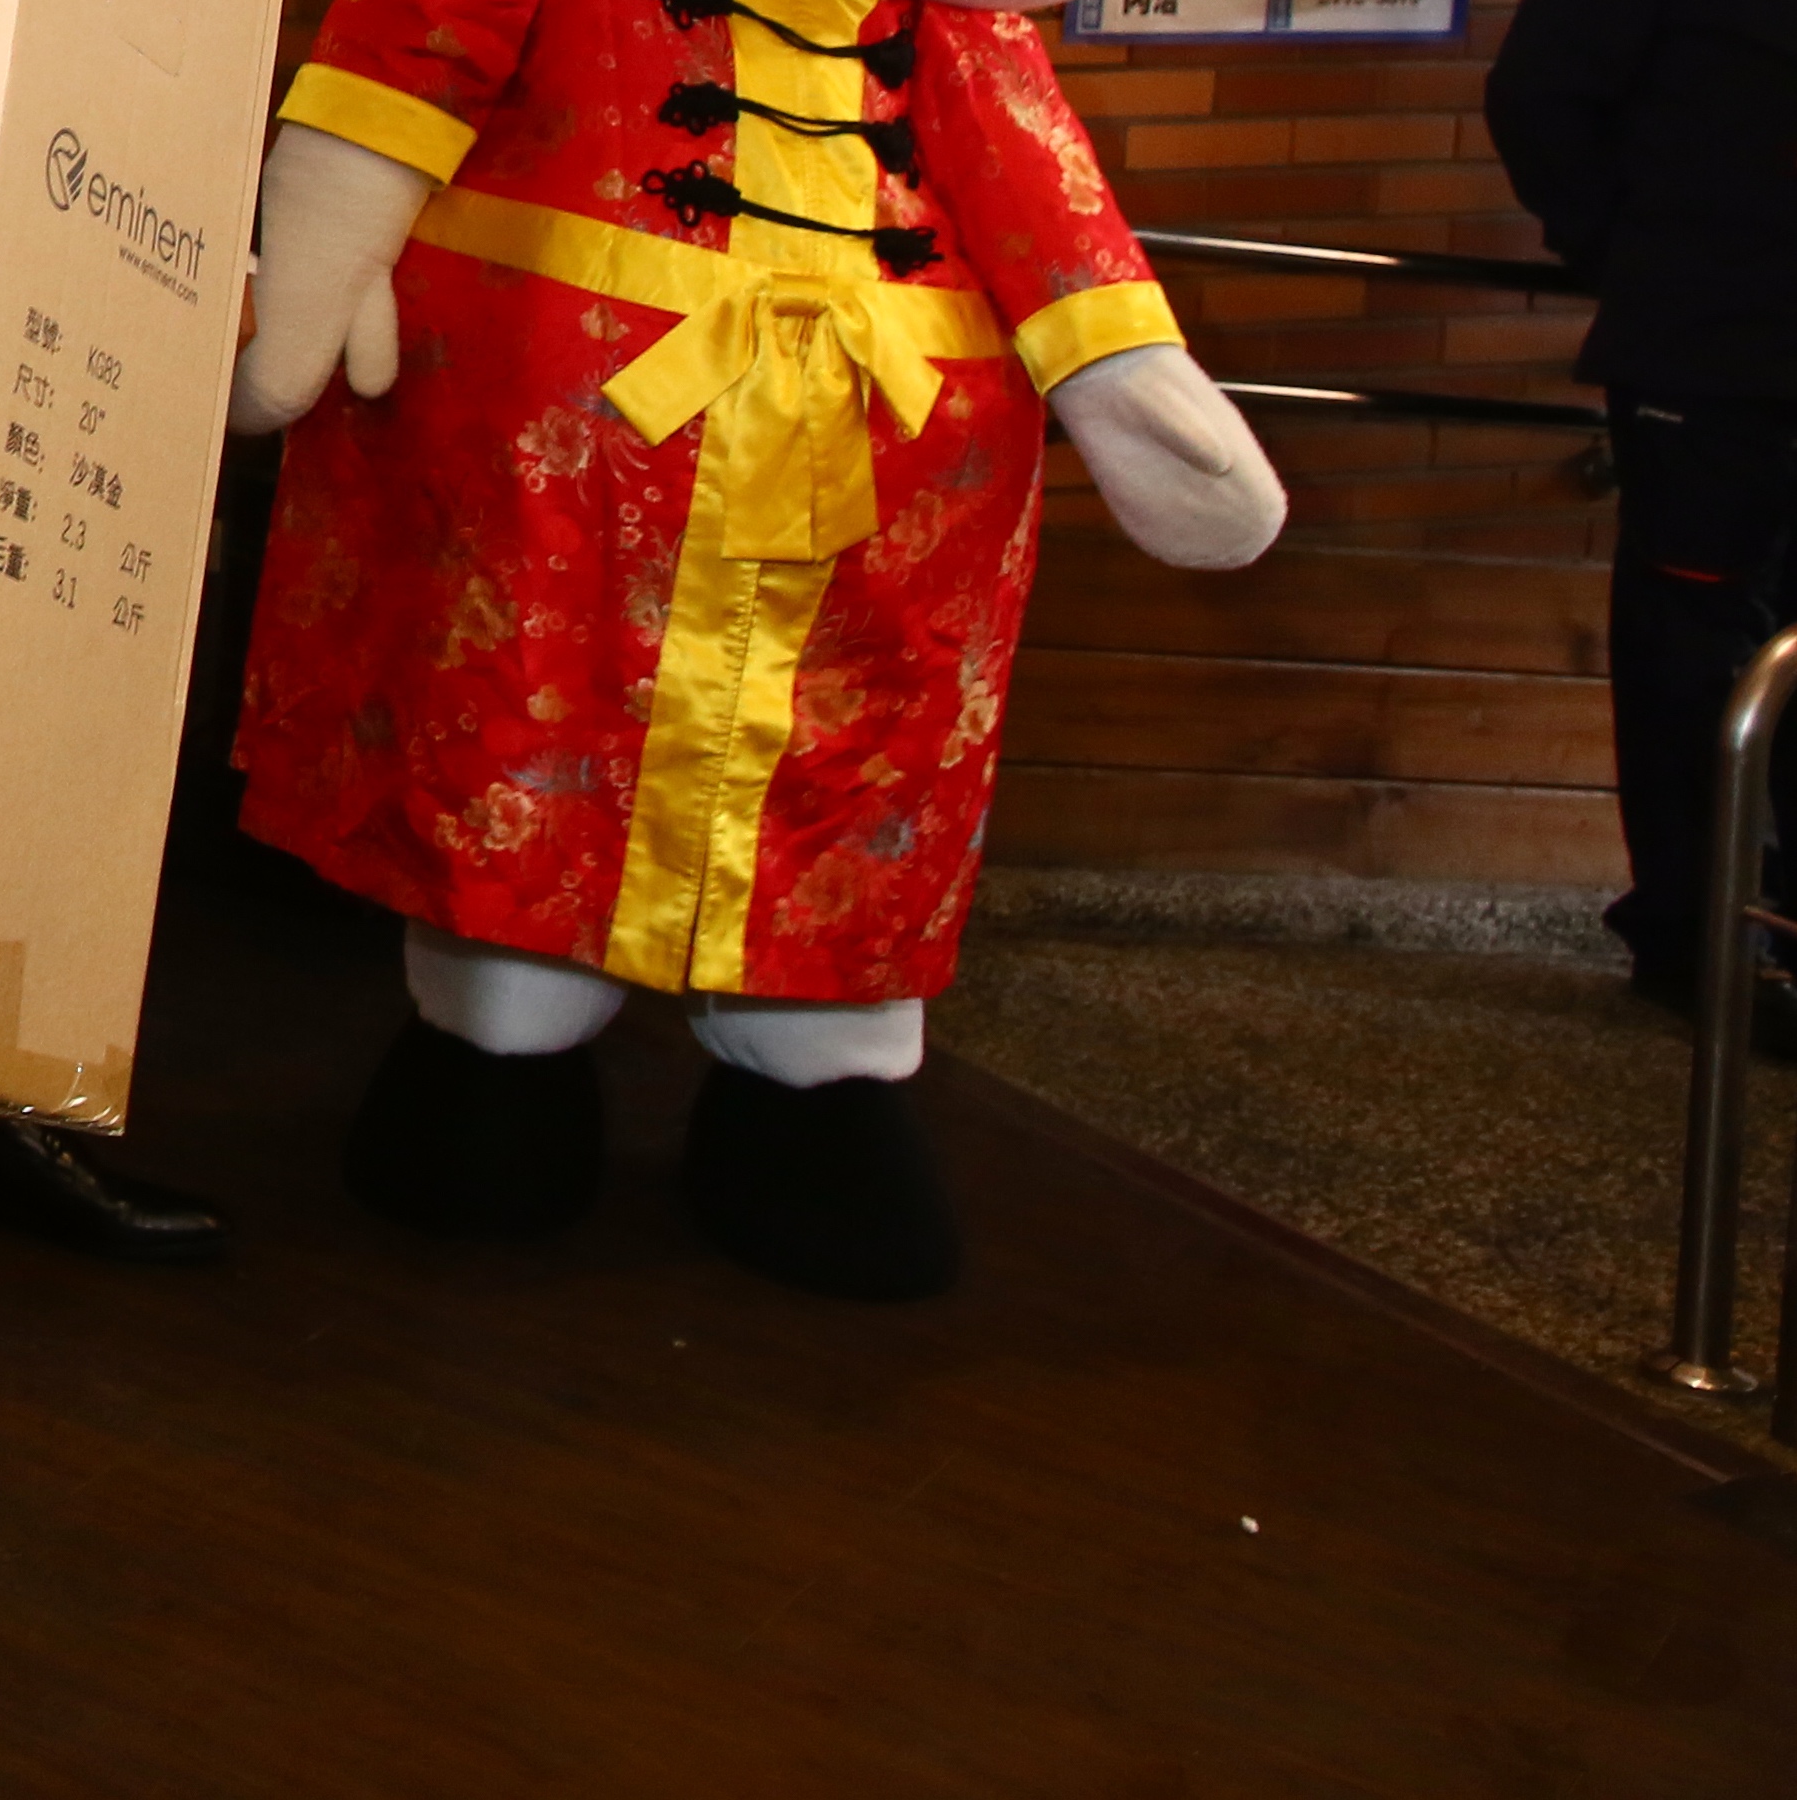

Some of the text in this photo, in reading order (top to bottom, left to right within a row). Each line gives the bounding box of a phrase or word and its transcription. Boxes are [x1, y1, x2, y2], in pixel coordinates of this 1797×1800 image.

[87, 172, 206, 281] eminent
[118, 244, 199, 308] www.eminent.com
[87, 345, 123, 391] KG82
[69, 451, 123, 510] 沙漠金
[60, 513, 87, 552] 2.3
[120, 543, 153, 584] 公斤
[51, 568, 78, 610] 3.1
[112, 596, 145, 636] 公斤
